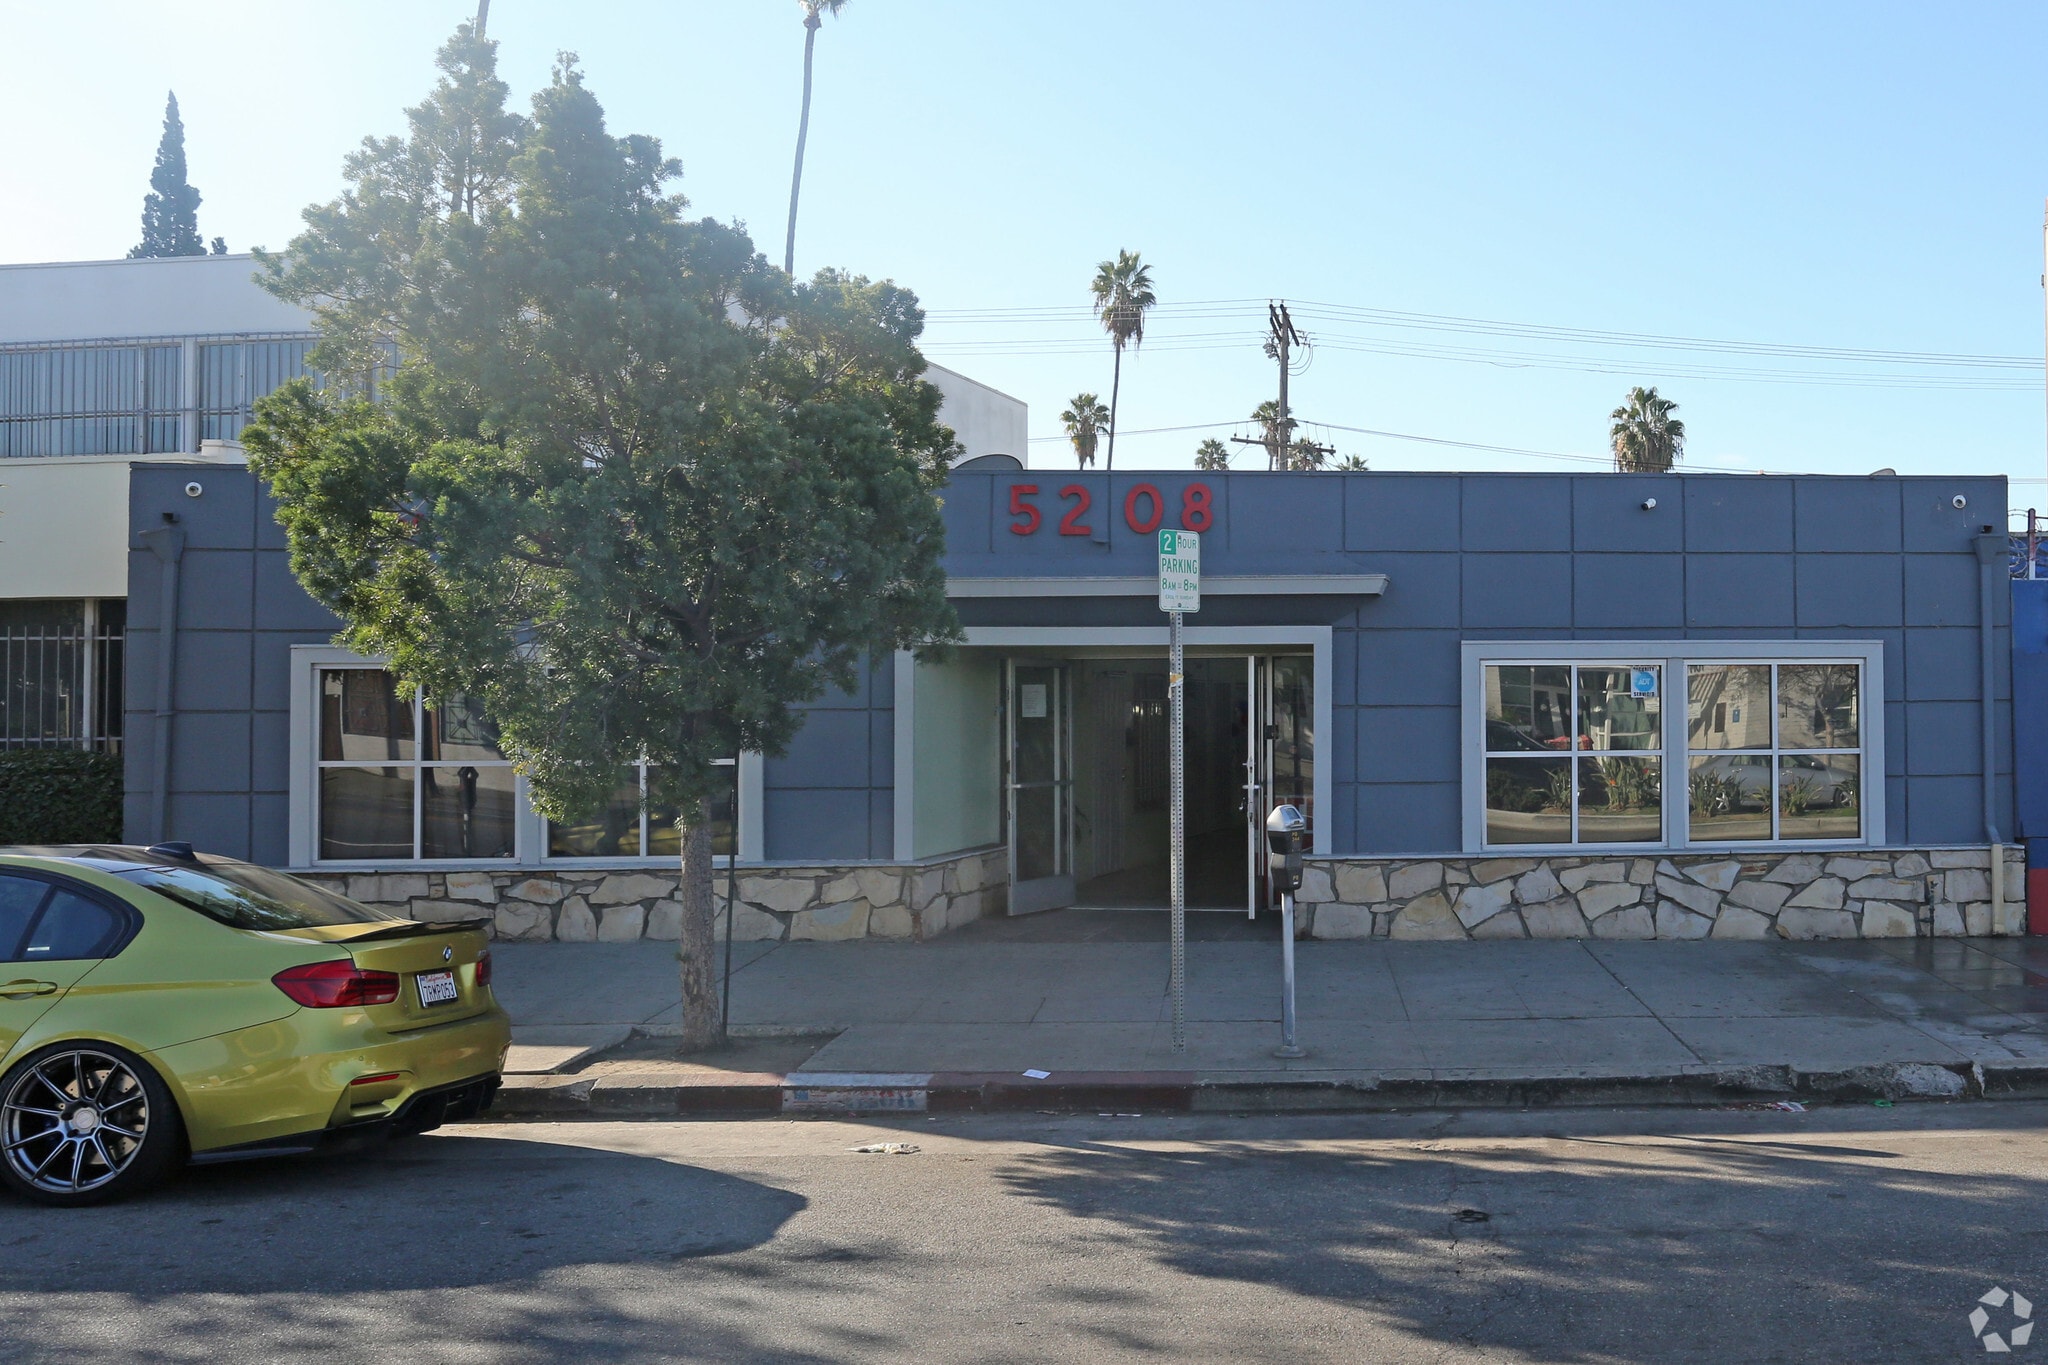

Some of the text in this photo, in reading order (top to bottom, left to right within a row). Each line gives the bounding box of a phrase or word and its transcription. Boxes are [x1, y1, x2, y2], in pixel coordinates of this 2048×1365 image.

[1164, 534, 1172, 551] 2
[1162, 558, 1197, 574] PARKING
[1161, 578, 1177, 590] 8AM
[1183, 579, 1197, 591] 8PM
[1638, 678, 1651, 686] ADT
